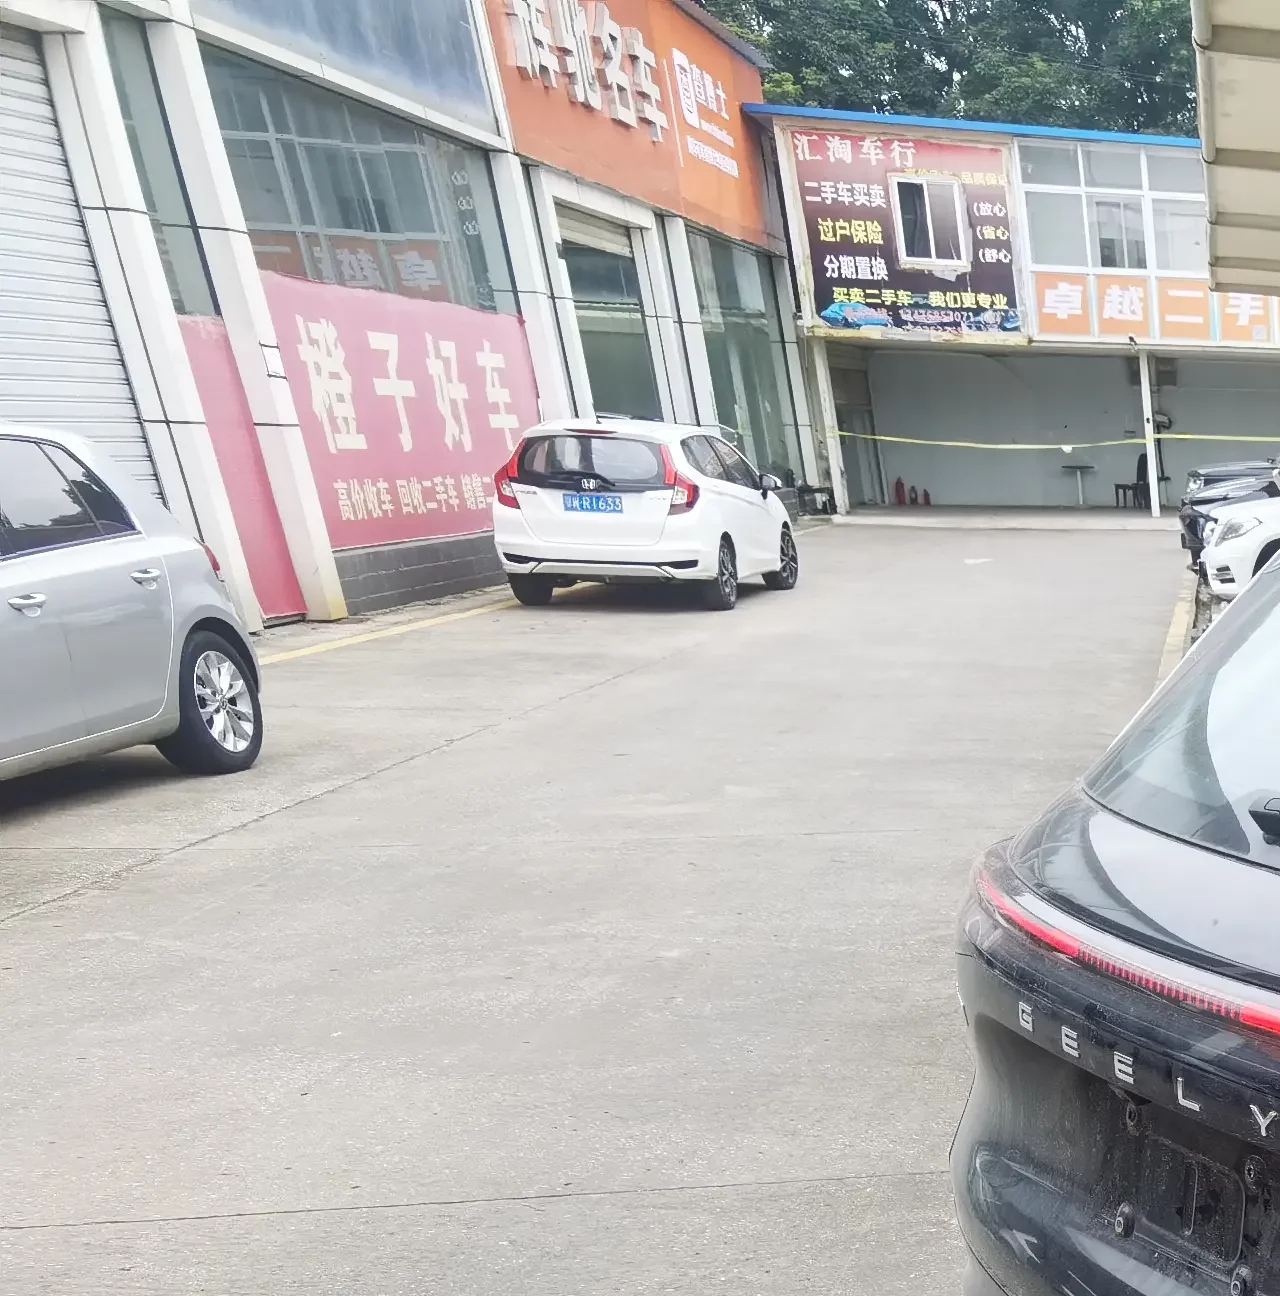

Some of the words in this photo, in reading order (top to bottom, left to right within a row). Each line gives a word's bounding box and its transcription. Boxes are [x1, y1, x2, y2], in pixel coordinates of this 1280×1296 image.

[804, 181, 887, 208] 二手车买卖
[817, 217, 884, 244] 过户保险
[824, 254, 889, 281] 分期置换
[832, 287, 915, 306] 买卖二手车
[928, 291, 1009, 309] 我们更专业
[295, 314, 520, 454] 橙子好车
[332, 477, 395, 521] 高价收车
[395, 475, 460, 515] 回收二手车
[1018, 1001, 1279, 1137] GEELY
